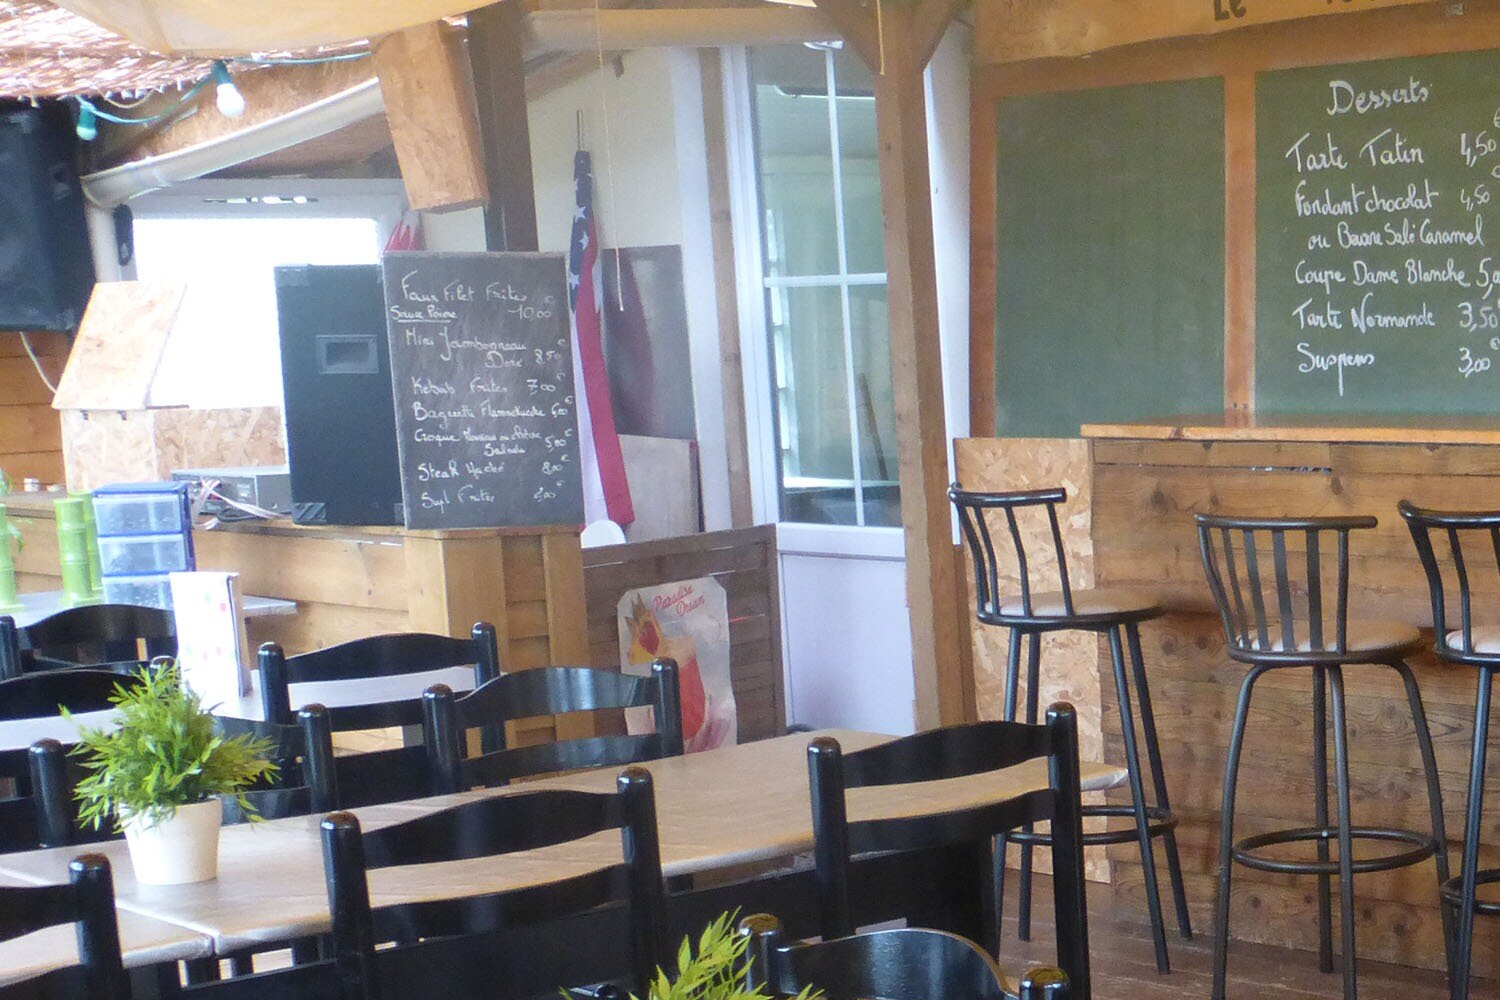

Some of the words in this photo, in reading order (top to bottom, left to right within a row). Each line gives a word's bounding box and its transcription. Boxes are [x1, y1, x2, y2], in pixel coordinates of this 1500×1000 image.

[1326, 76, 1430, 115] Desserts
[1286, 132, 1348, 173] Tarte
[1359, 128, 1424, 167] Tatin
[1295, 180, 1365, 217] Fondant
[1365, 178, 1439, 213] chocolat
[1308, 232, 1331, 250] ou
[1420, 214, 1485, 247] Caramel
[401, 270, 439, 302] Faux
[443, 279, 475, 301] Filet
[486, 282, 527, 301] Frites
[1295, 260, 1346, 295] Coupe
[1353, 260, 1399, 286] Dame
[1405, 258, 1472, 288] Blanche
[1292, 298, 1342, 330] Tarte
[1351, 292, 1436, 334] Normande
